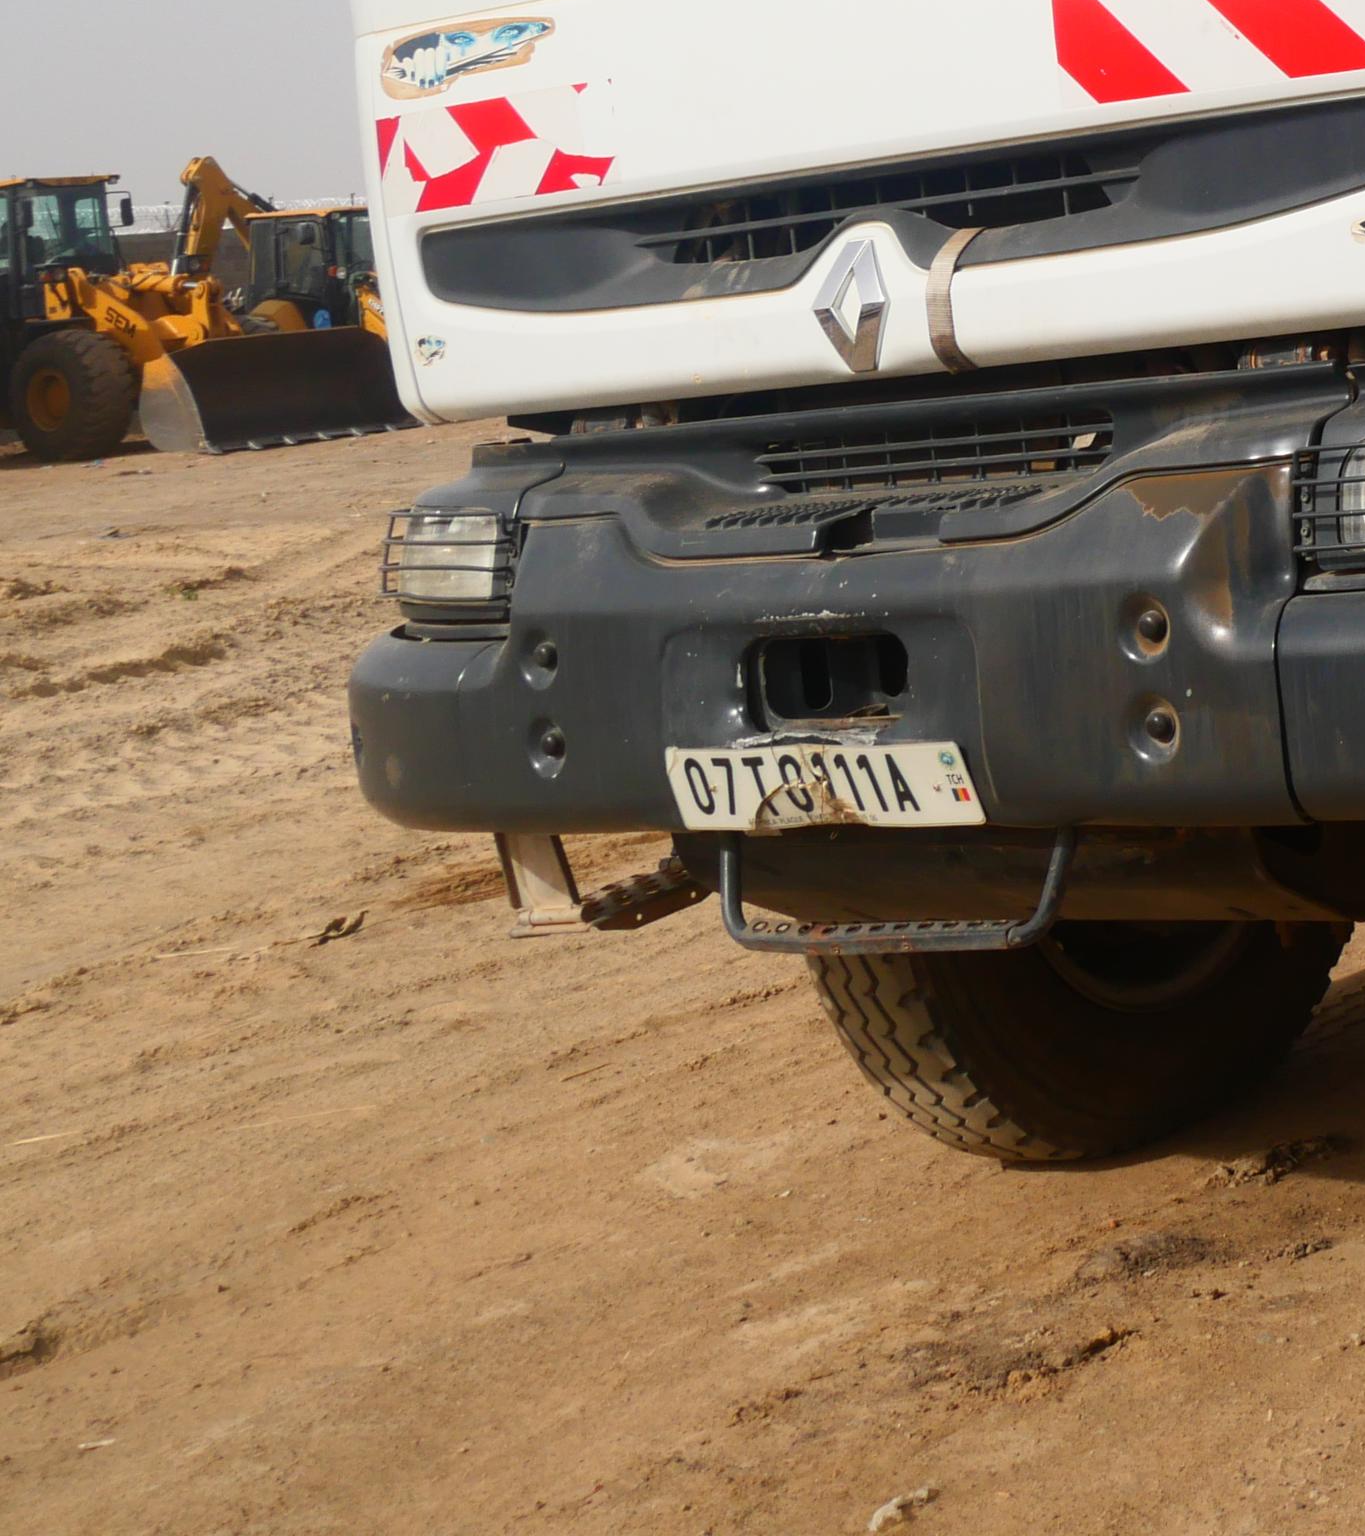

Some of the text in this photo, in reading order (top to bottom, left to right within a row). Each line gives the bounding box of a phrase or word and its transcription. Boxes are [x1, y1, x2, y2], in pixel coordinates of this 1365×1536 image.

[104, 305, 137, 338] SEM
[684, 753, 922, 817] 07T0111A
[945, 774, 965, 784] TCH
